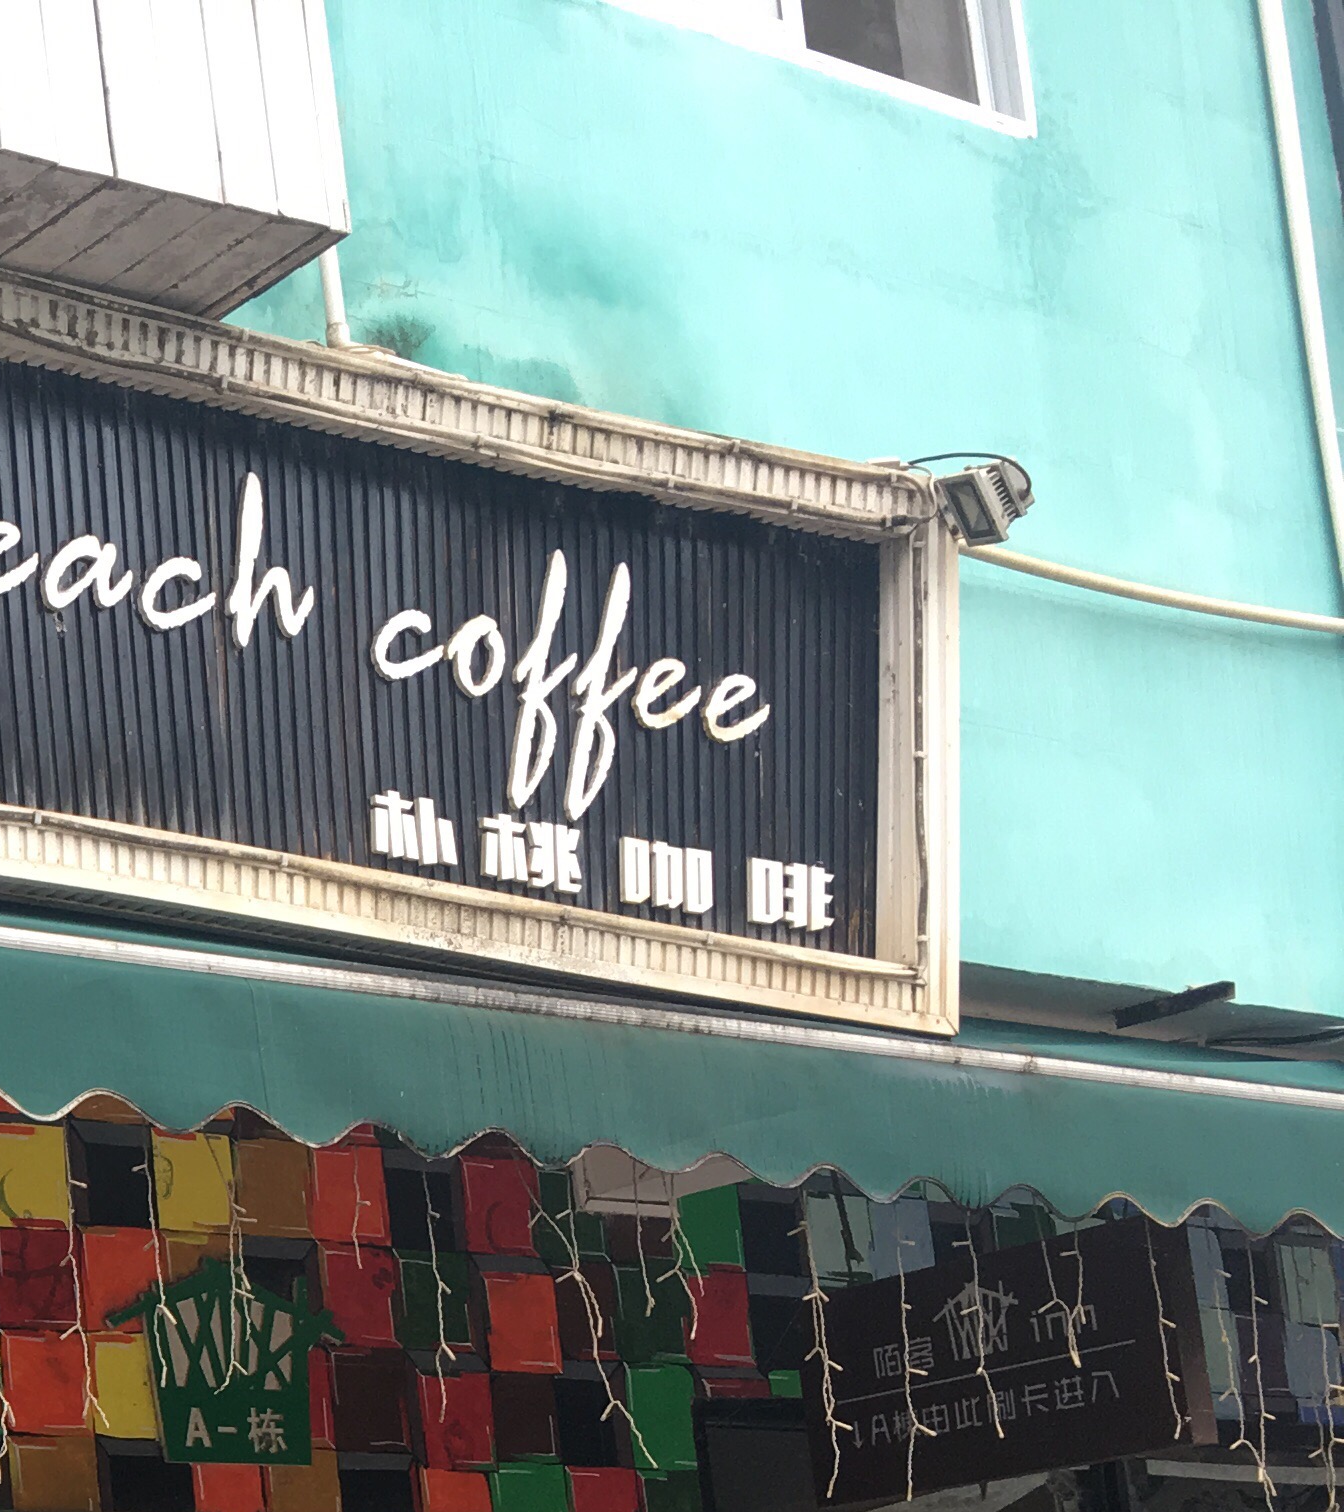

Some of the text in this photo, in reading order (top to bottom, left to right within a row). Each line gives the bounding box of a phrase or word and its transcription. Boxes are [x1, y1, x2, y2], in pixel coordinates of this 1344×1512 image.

[370, 548, 771, 820] coffee
[369, 789, 835, 932] 朴桃咖啡
